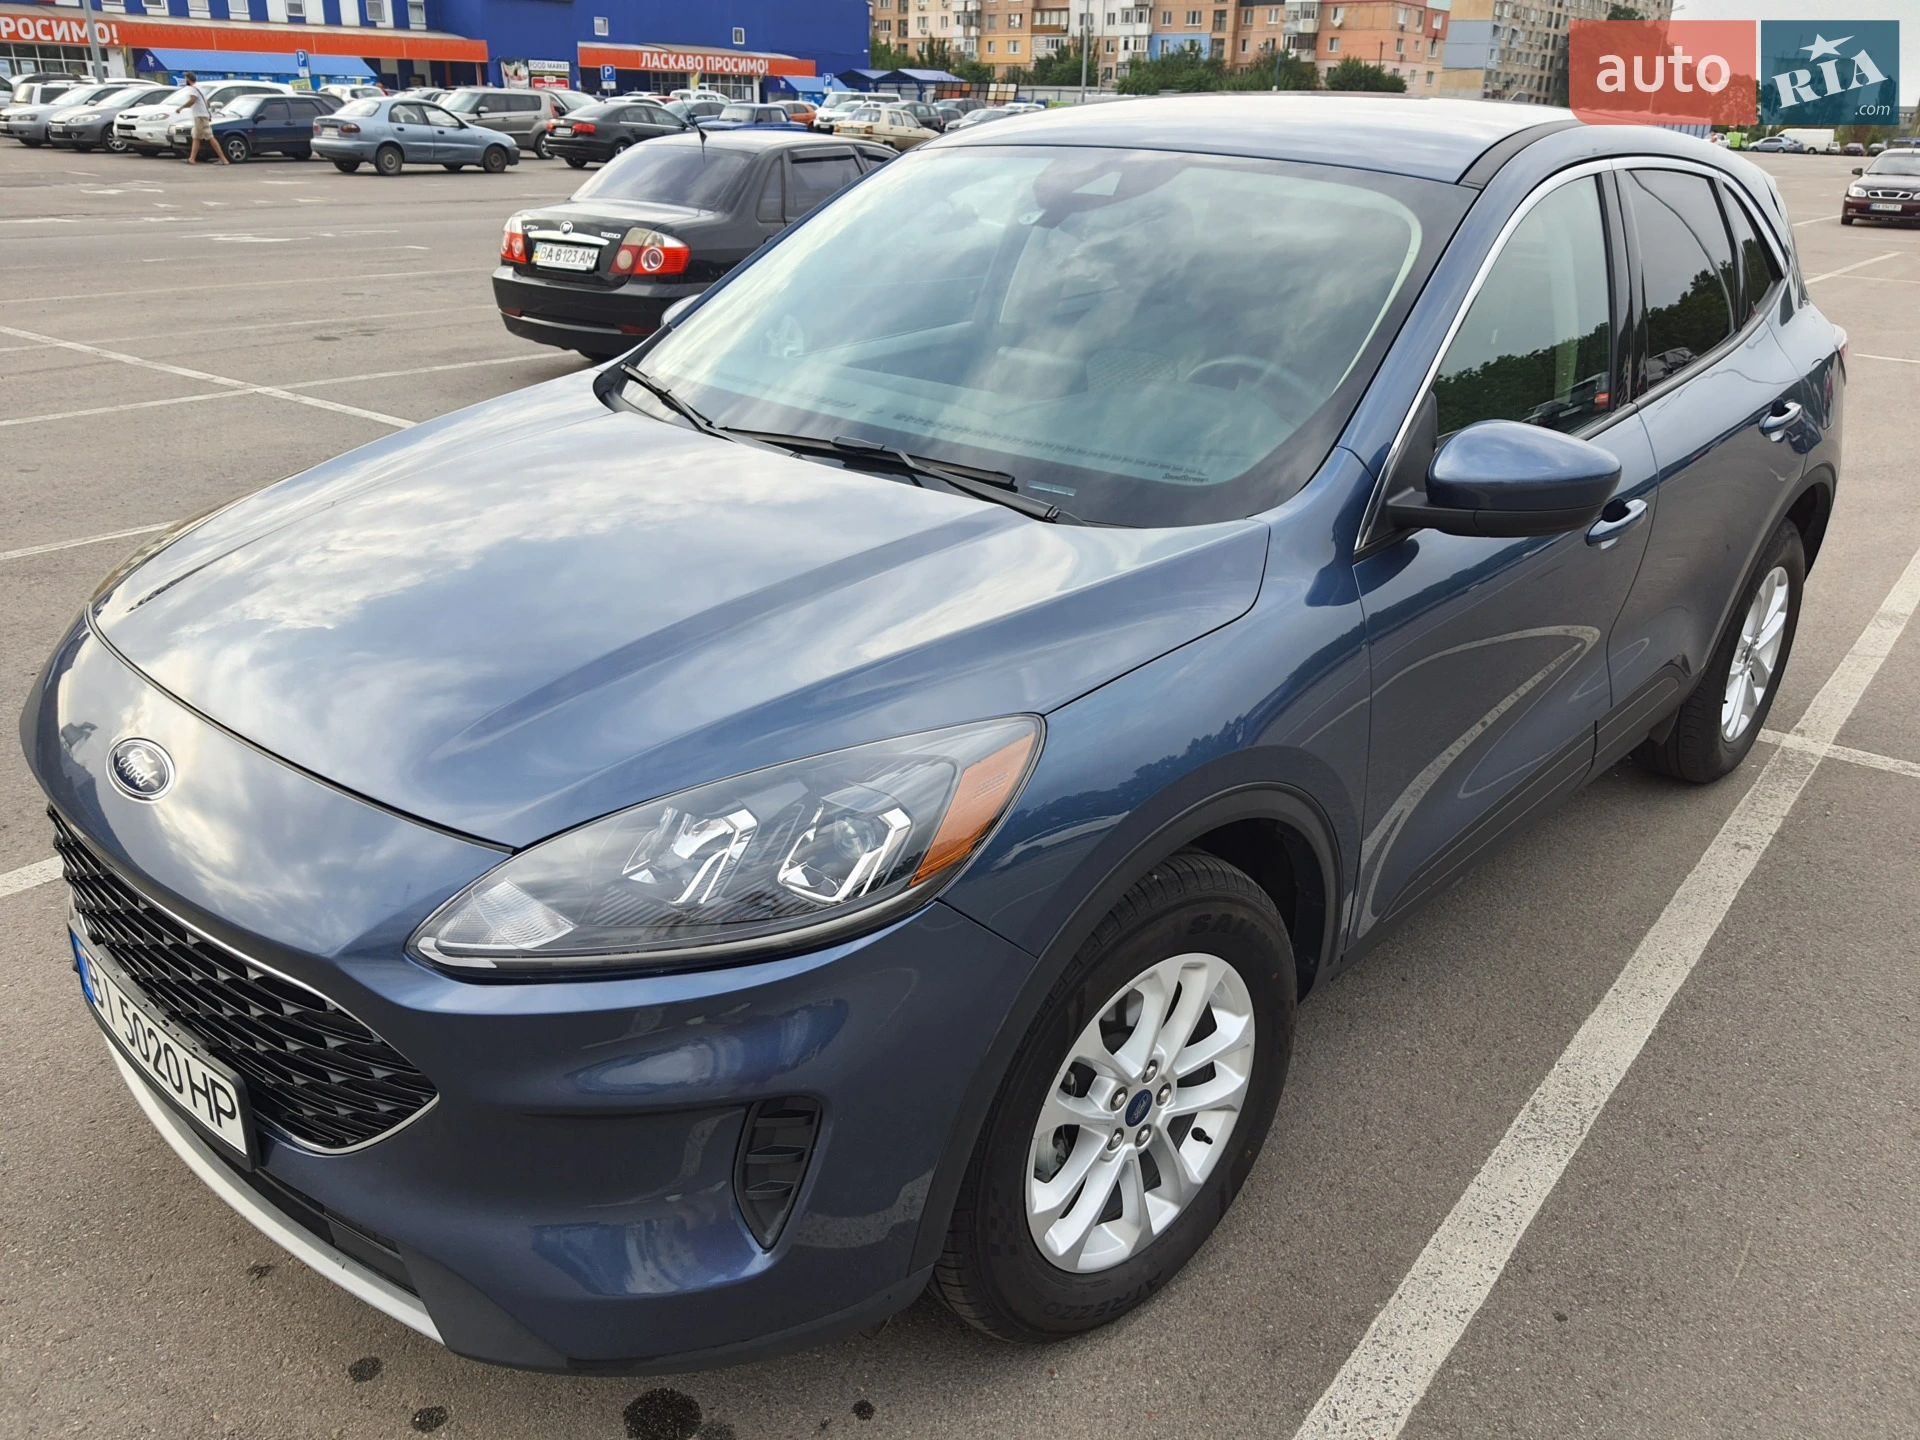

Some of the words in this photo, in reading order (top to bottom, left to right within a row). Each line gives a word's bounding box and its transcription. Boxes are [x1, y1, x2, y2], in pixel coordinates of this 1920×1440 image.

[529, 61, 546, 69] FOOD
[547, 62, 569, 70] MARKET
[641, 52, 704, 70] ЛАСКАВО
[706, 56, 769, 74] ПРОСИМО!
[604, 66, 612, 79] P
[539, 246, 553, 261] BA
[118, 746, 159, 788] Ford
[88, 953, 116, 1025] BI
[121, 996, 184, 1095] 5020
[184, 1056, 237, 1129] HP
